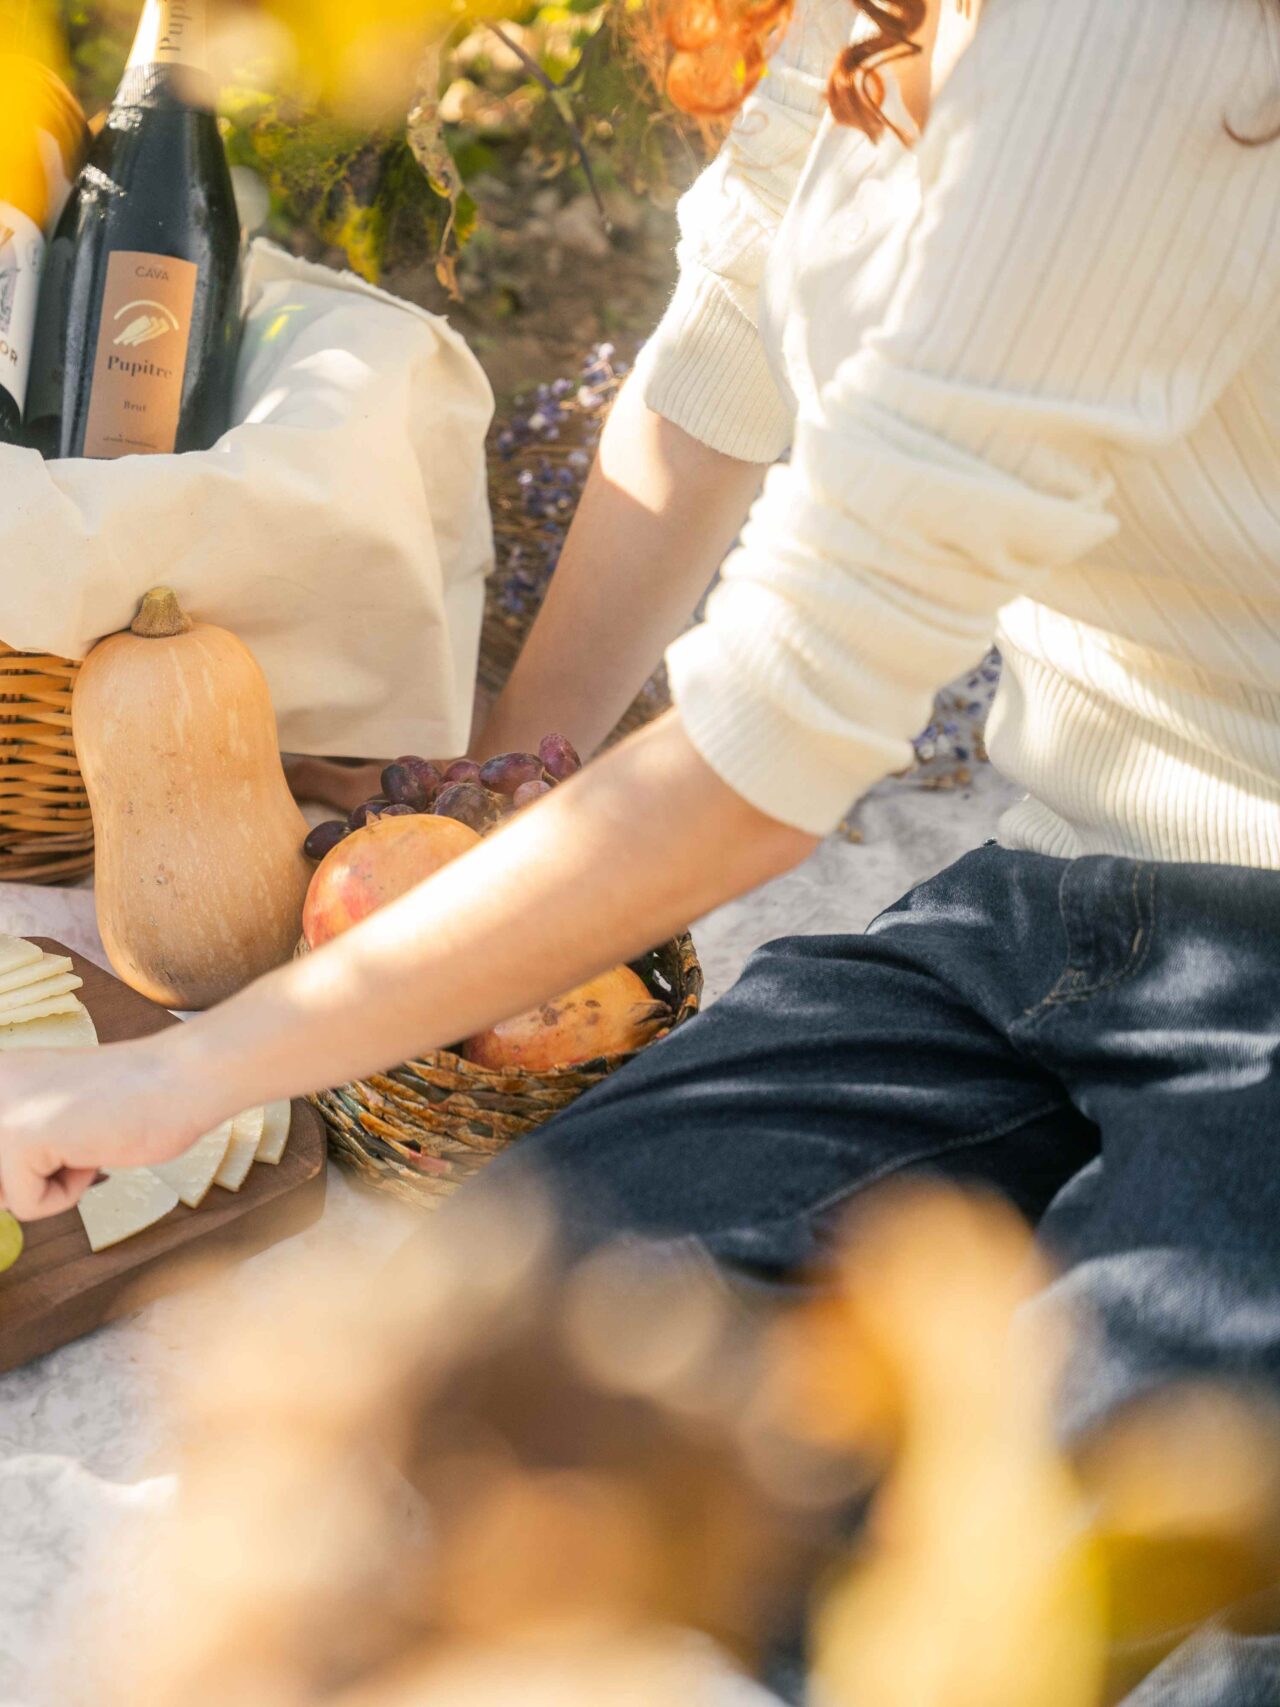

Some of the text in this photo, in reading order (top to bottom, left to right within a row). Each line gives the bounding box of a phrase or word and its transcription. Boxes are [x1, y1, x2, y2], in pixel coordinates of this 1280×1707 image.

[134, 265, 169, 281] CAVA
[107, 355, 173, 378] Pupitre
[122, 399, 148, 413] Brut
